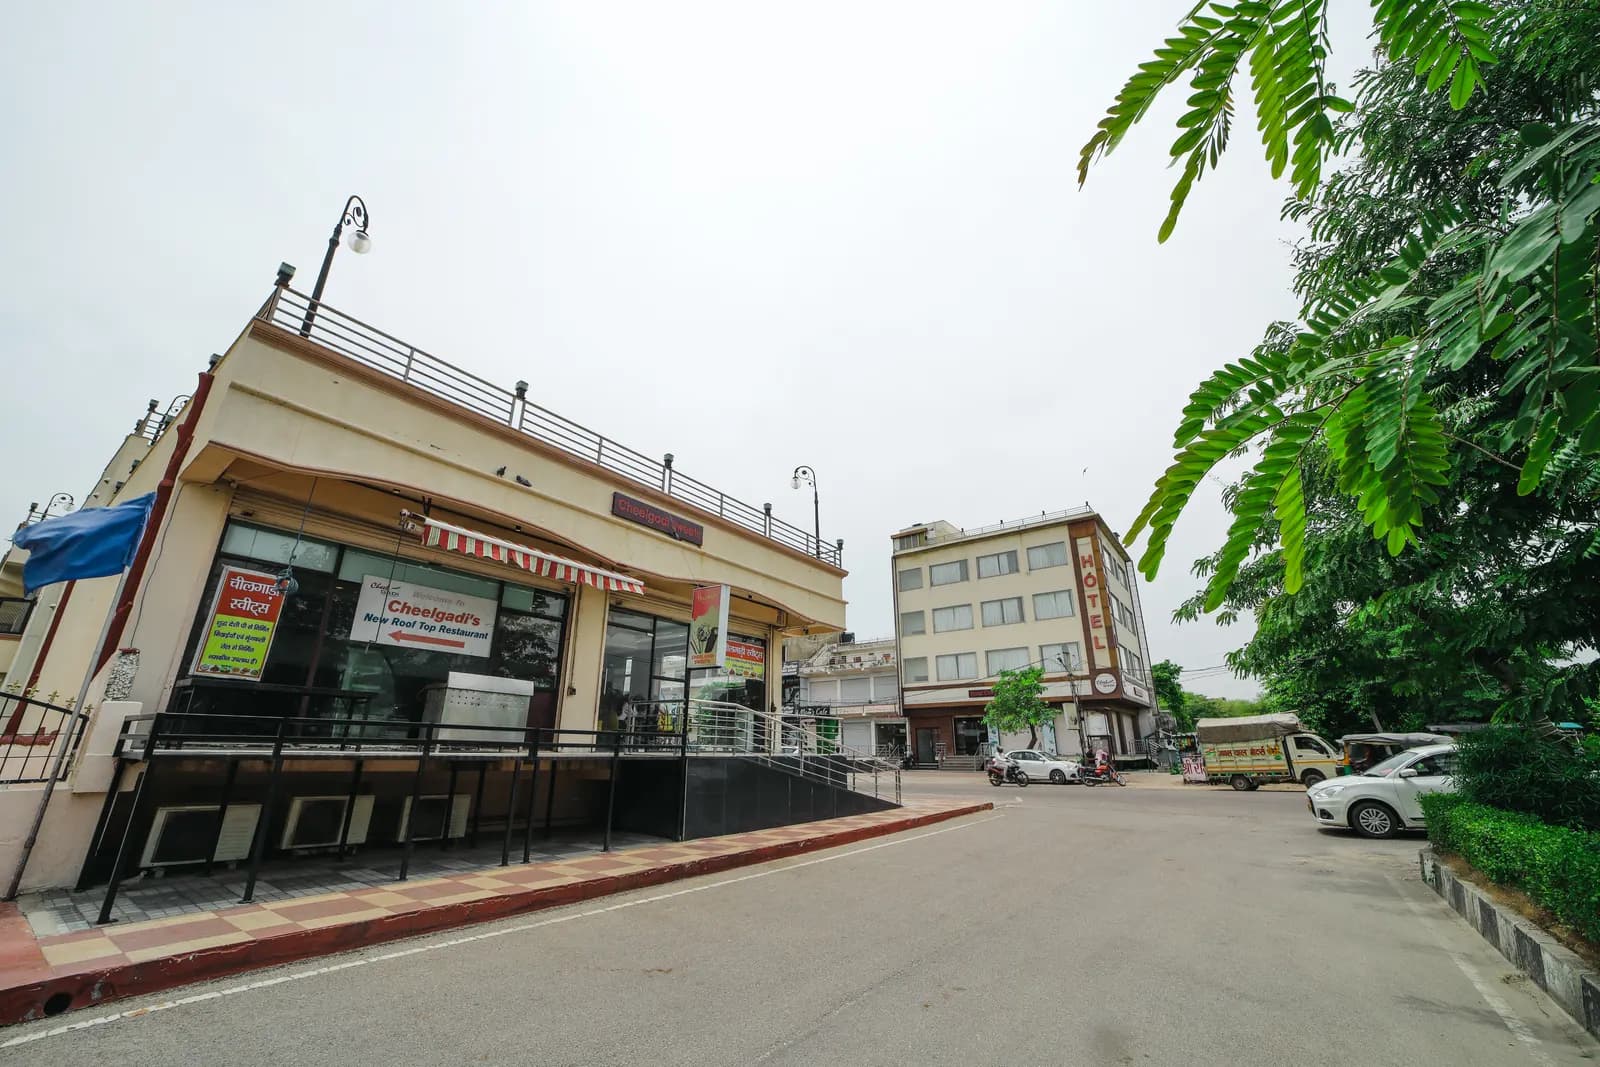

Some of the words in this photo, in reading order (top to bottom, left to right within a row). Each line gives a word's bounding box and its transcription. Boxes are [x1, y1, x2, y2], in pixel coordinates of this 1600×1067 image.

[230, 596, 271, 616] स्वीट्स
[388, 600, 481, 626] Cheelgadi's
[1080, 554, 1106, 650] HOTEL
[363, 613, 388, 625] New
[391, 619, 417, 629] Roof
[419, 621, 437, 633] Top
[438, 625, 489, 640] Restaurant
